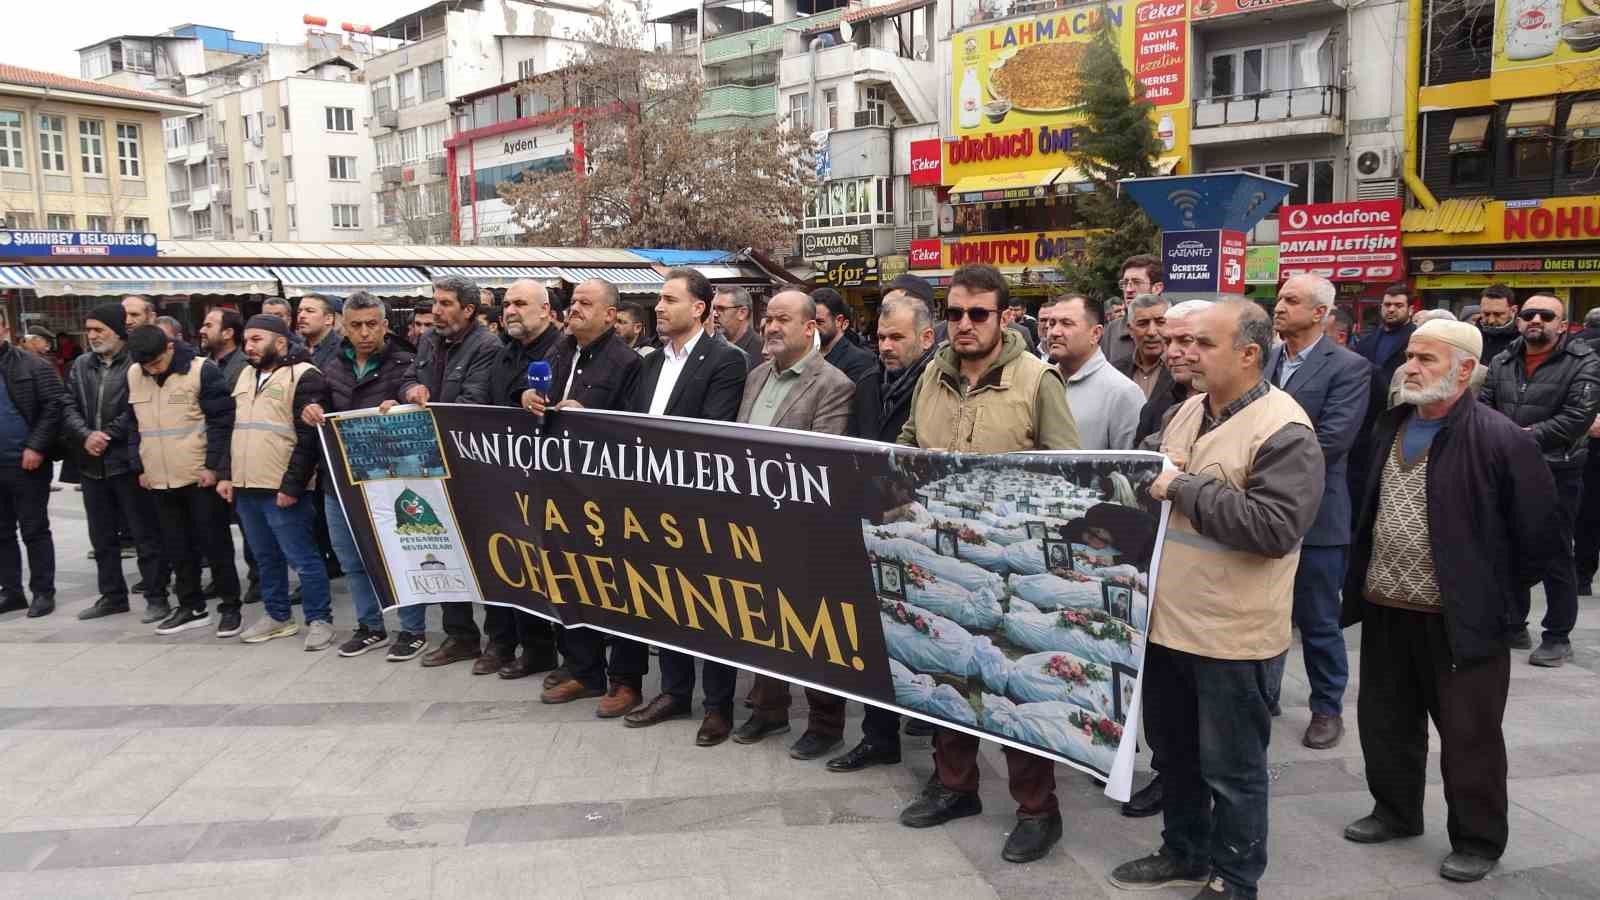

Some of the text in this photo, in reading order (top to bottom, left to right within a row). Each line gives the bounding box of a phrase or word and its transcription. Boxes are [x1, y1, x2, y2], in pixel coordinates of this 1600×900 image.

[1142, 28, 1178, 41] ADIYLA
[503, 136, 538, 155] Aydent
[949, 128, 1033, 165] DÜRÜMCÜ
[1312, 208, 1391, 225] vodafone
[1504, 206, 1600, 241] NOHU
[816, 233, 859, 248] KUAFÖR
[1280, 234, 1397, 253] DAYAN İLETİŞİM
[950, 239, 1030, 265] NOHUTCU
[828, 262, 864, 286] efor
[1544, 258, 1575, 270] ÖMER
[449, 425, 832, 510] KAN İÇİCİ ZALİMLER İÇİN
[487, 531, 866, 672] CEHENNEM!
